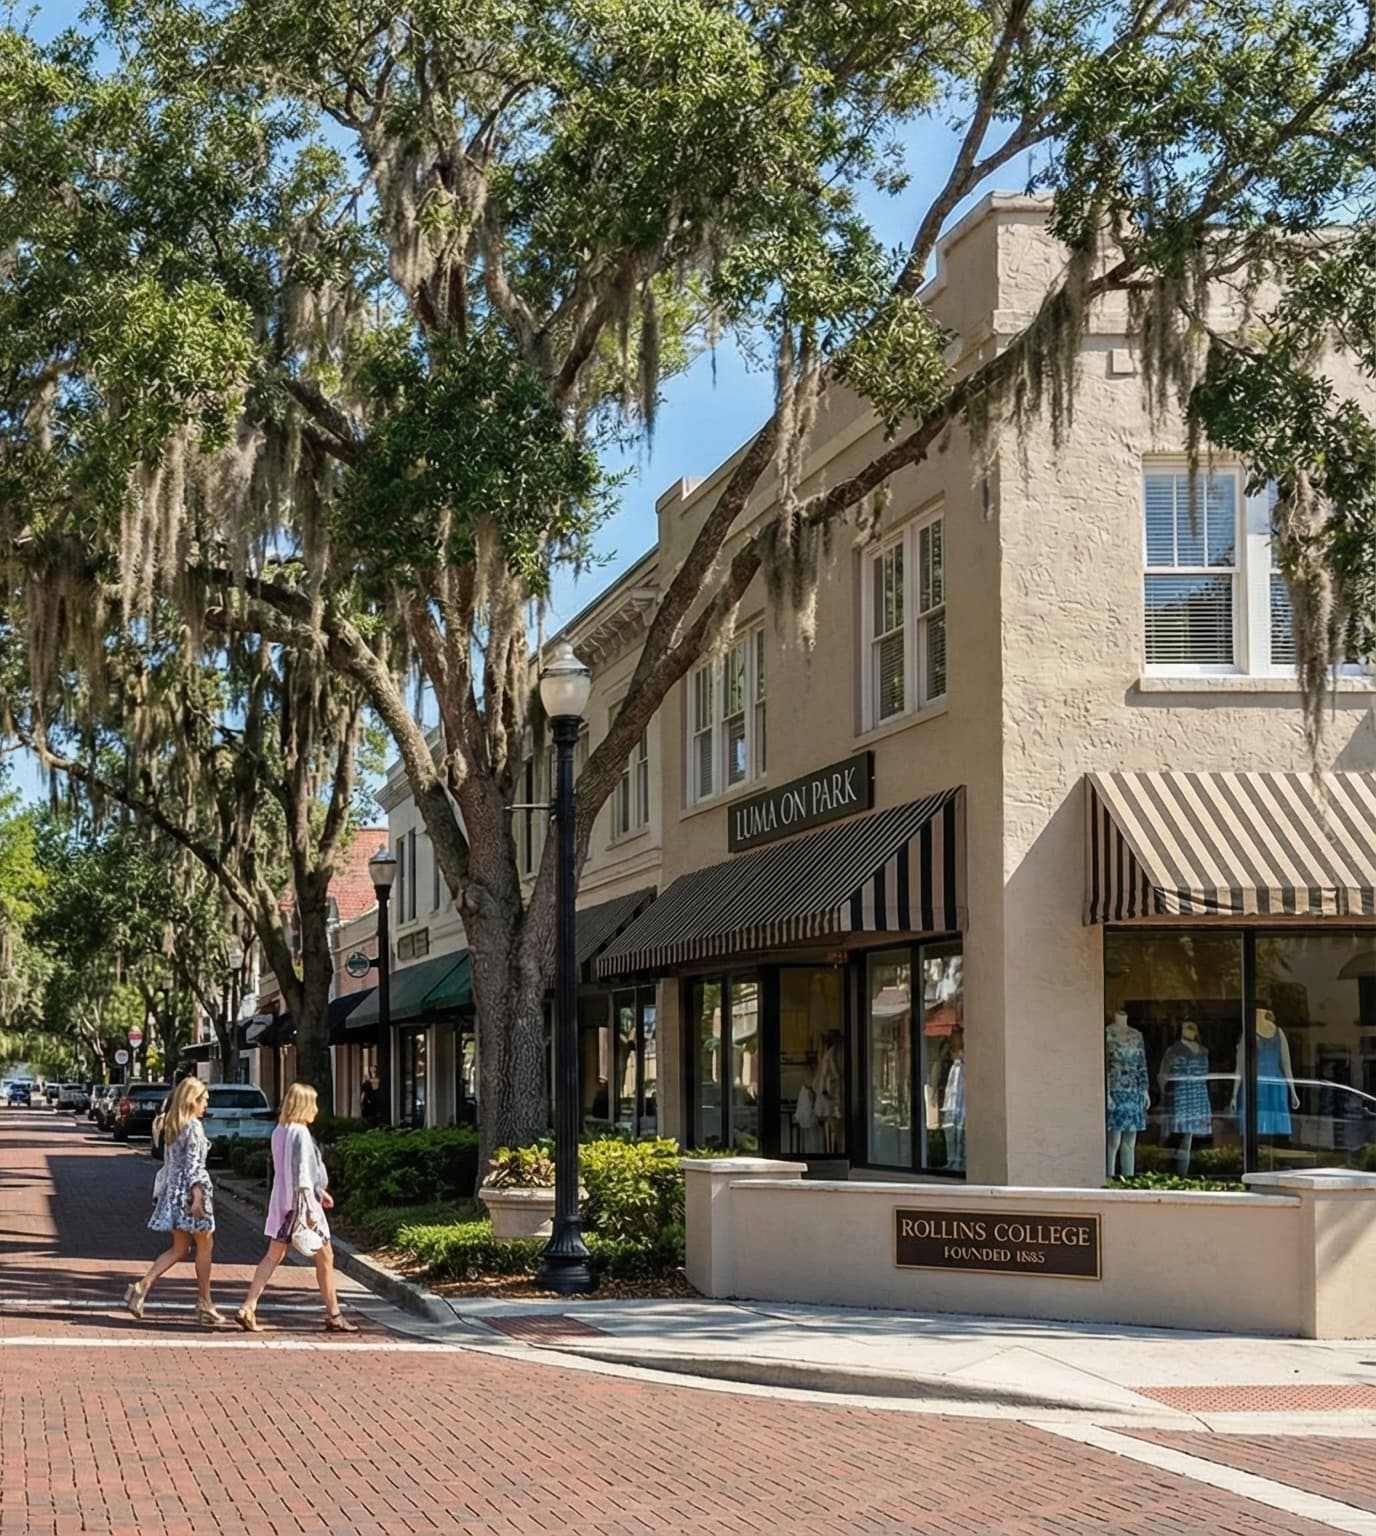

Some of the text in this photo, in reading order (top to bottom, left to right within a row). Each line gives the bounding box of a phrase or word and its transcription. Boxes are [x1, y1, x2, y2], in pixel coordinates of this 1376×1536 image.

[736, 766, 857, 841] LUMA ON PARK
[902, 1218, 1090, 1246] ROLLINS COLLEGE
[944, 1246, 1011, 1262] FOUNDED
